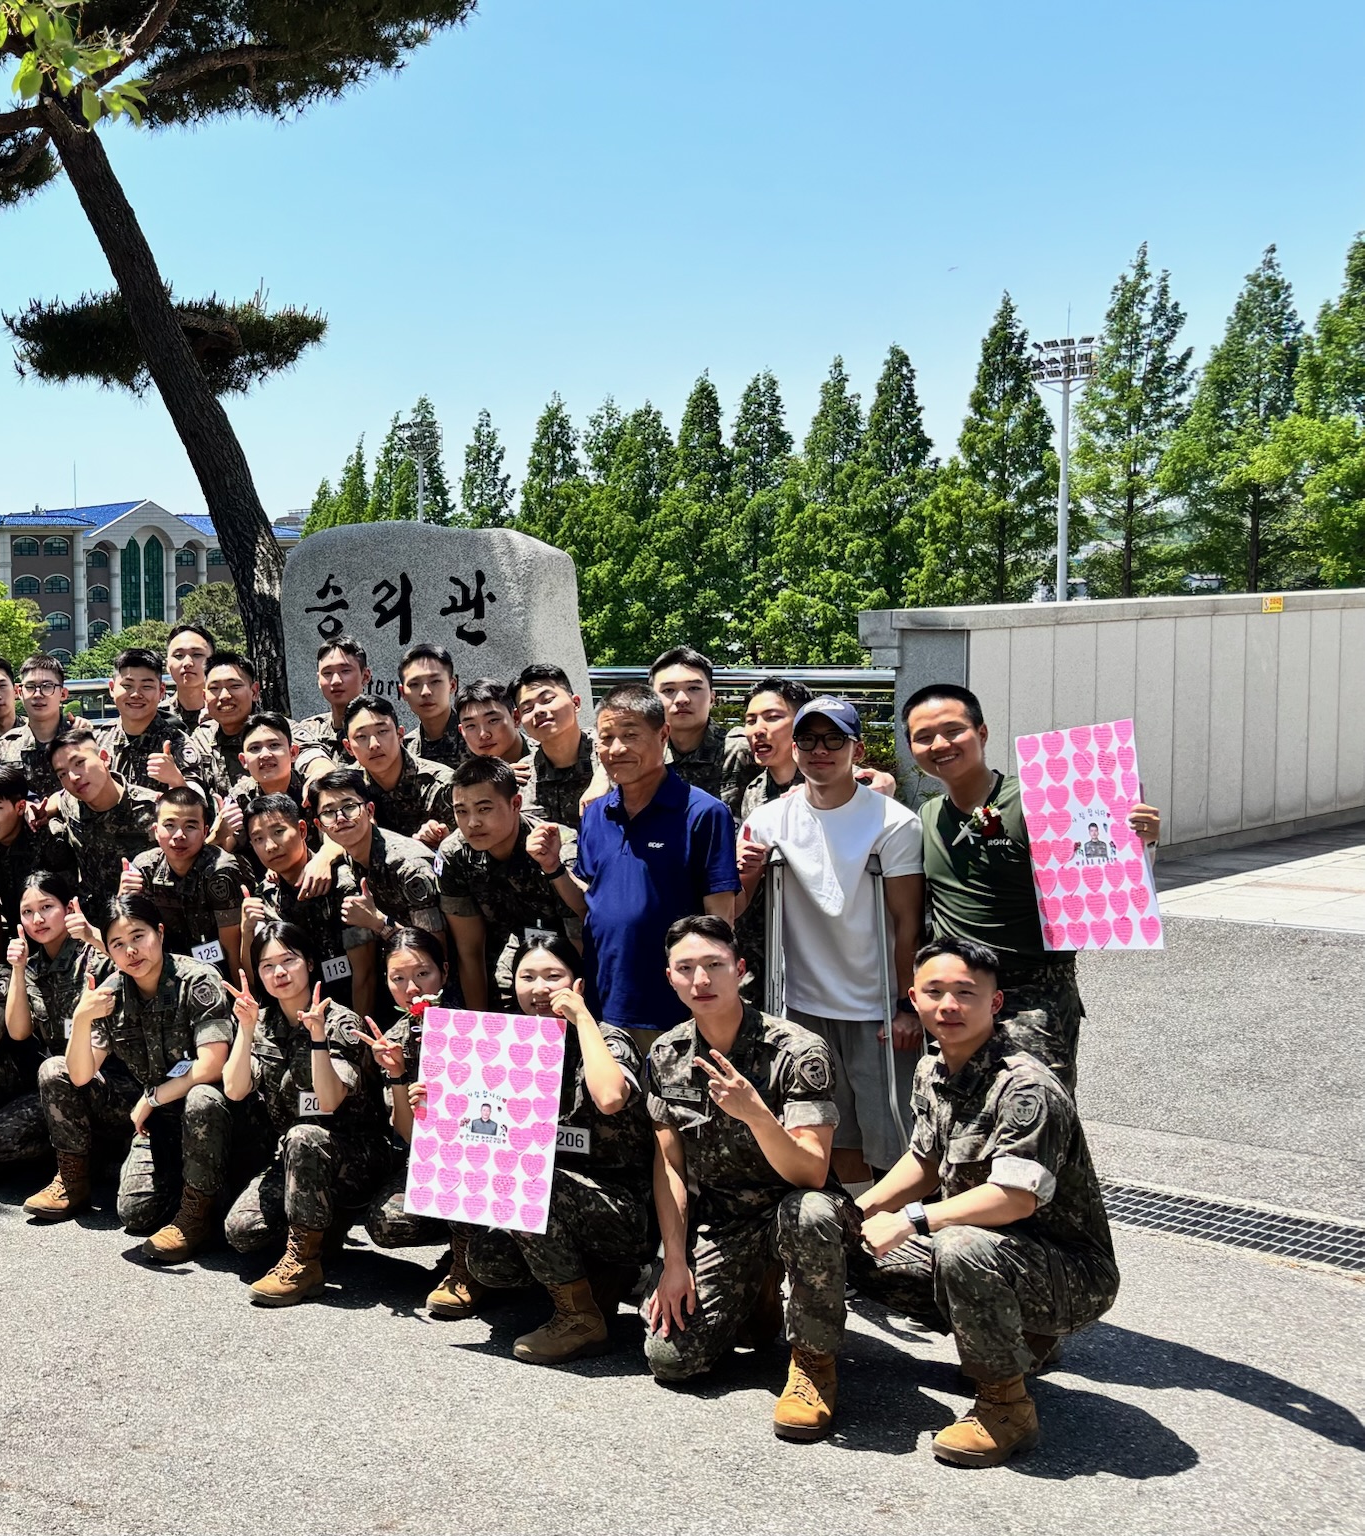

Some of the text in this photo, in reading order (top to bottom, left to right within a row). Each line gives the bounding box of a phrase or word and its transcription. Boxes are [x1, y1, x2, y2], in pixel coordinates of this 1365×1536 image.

[305, 570, 496, 646] 승리관
[987, 838, 1013, 846] ROKA
[198, 946, 219, 961] 125
[326, 961, 347, 977] 113
[304, 1097, 320, 1111] 20
[556, 1131, 584, 1148] 206
